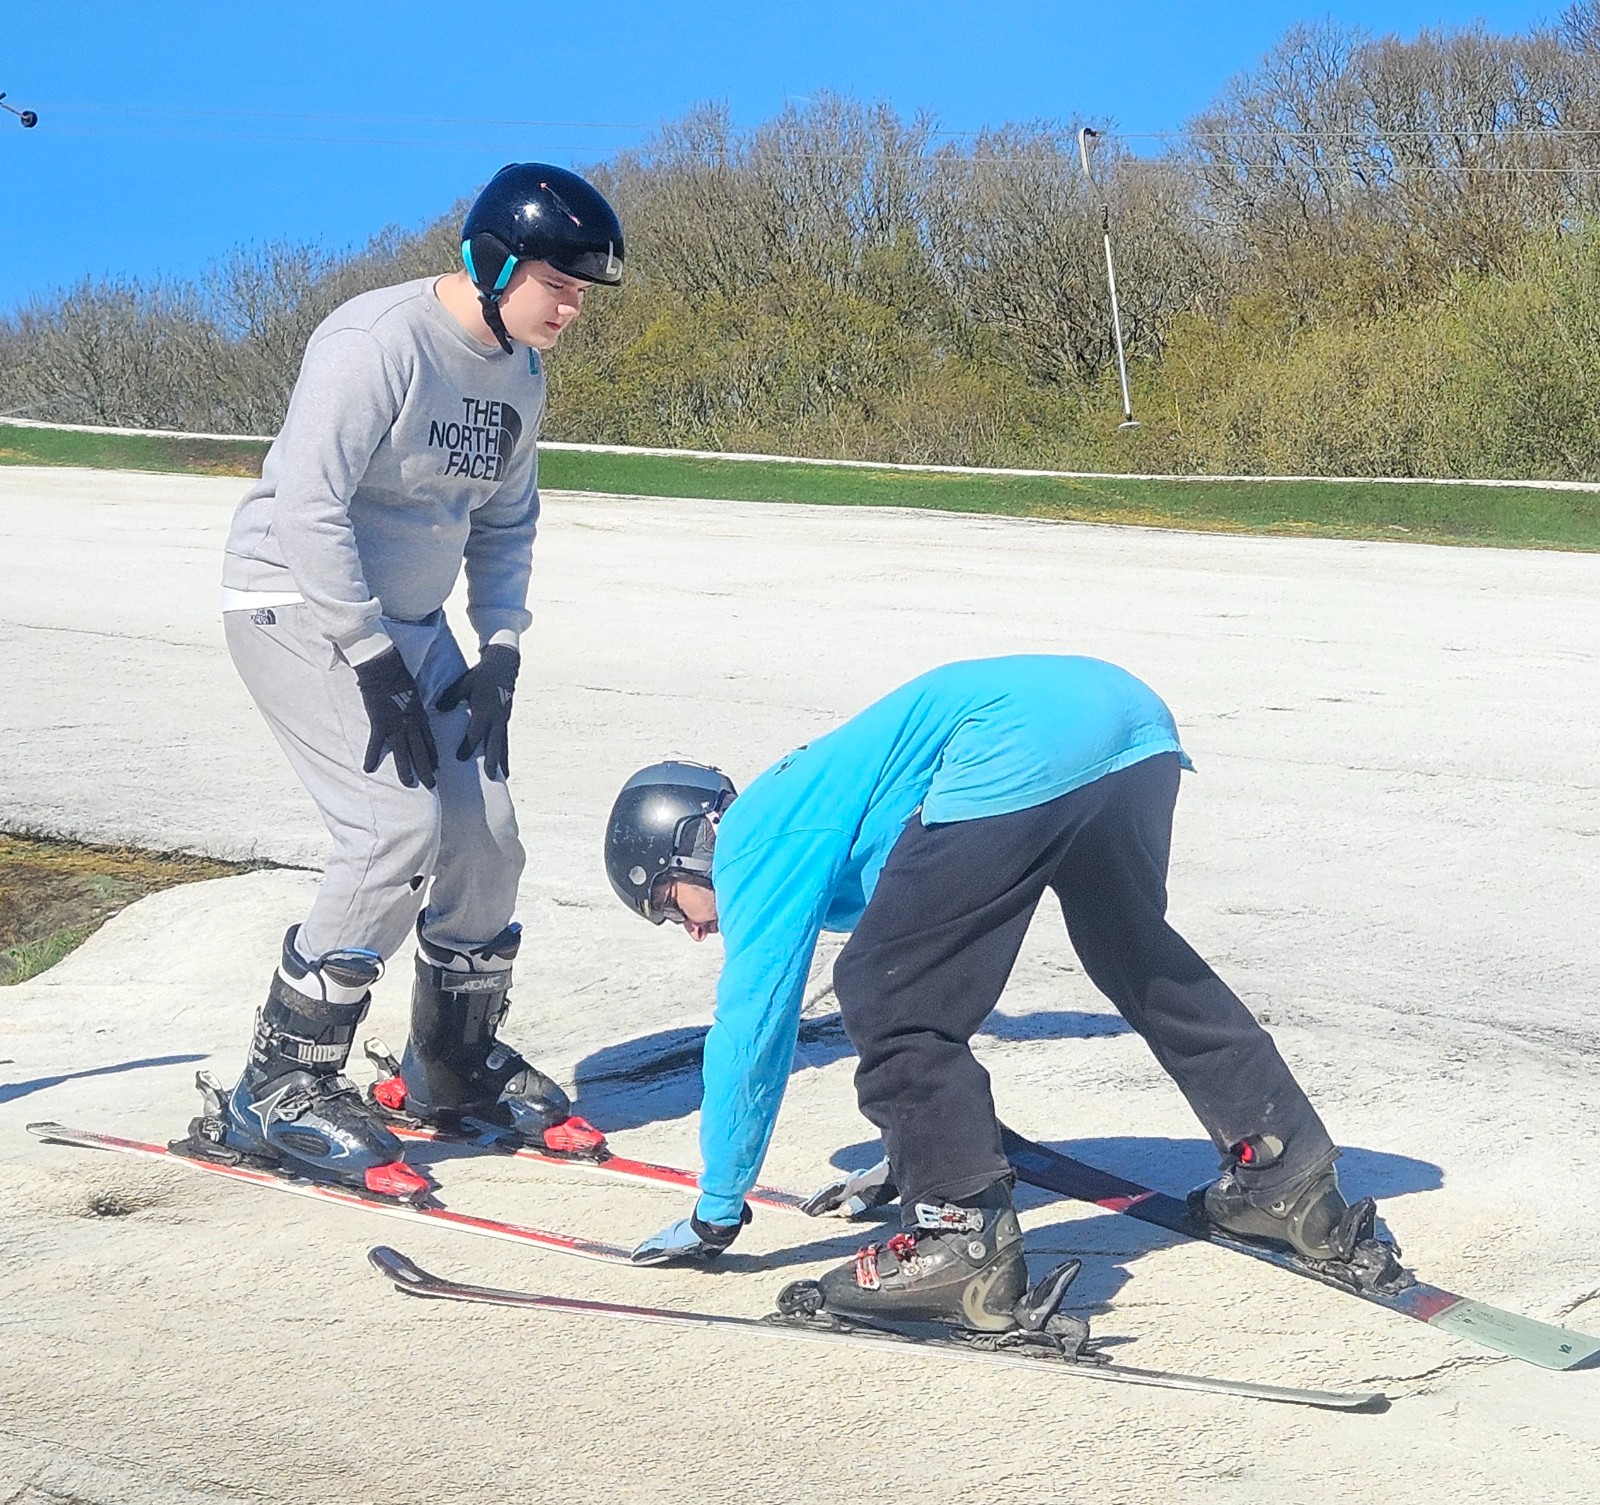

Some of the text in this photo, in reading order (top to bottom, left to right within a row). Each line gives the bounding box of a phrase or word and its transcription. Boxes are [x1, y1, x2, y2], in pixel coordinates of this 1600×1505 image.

[462, 397, 500, 427] THE
[428, 420, 499, 455] NORTH
[444, 451, 496, 481] FACE
